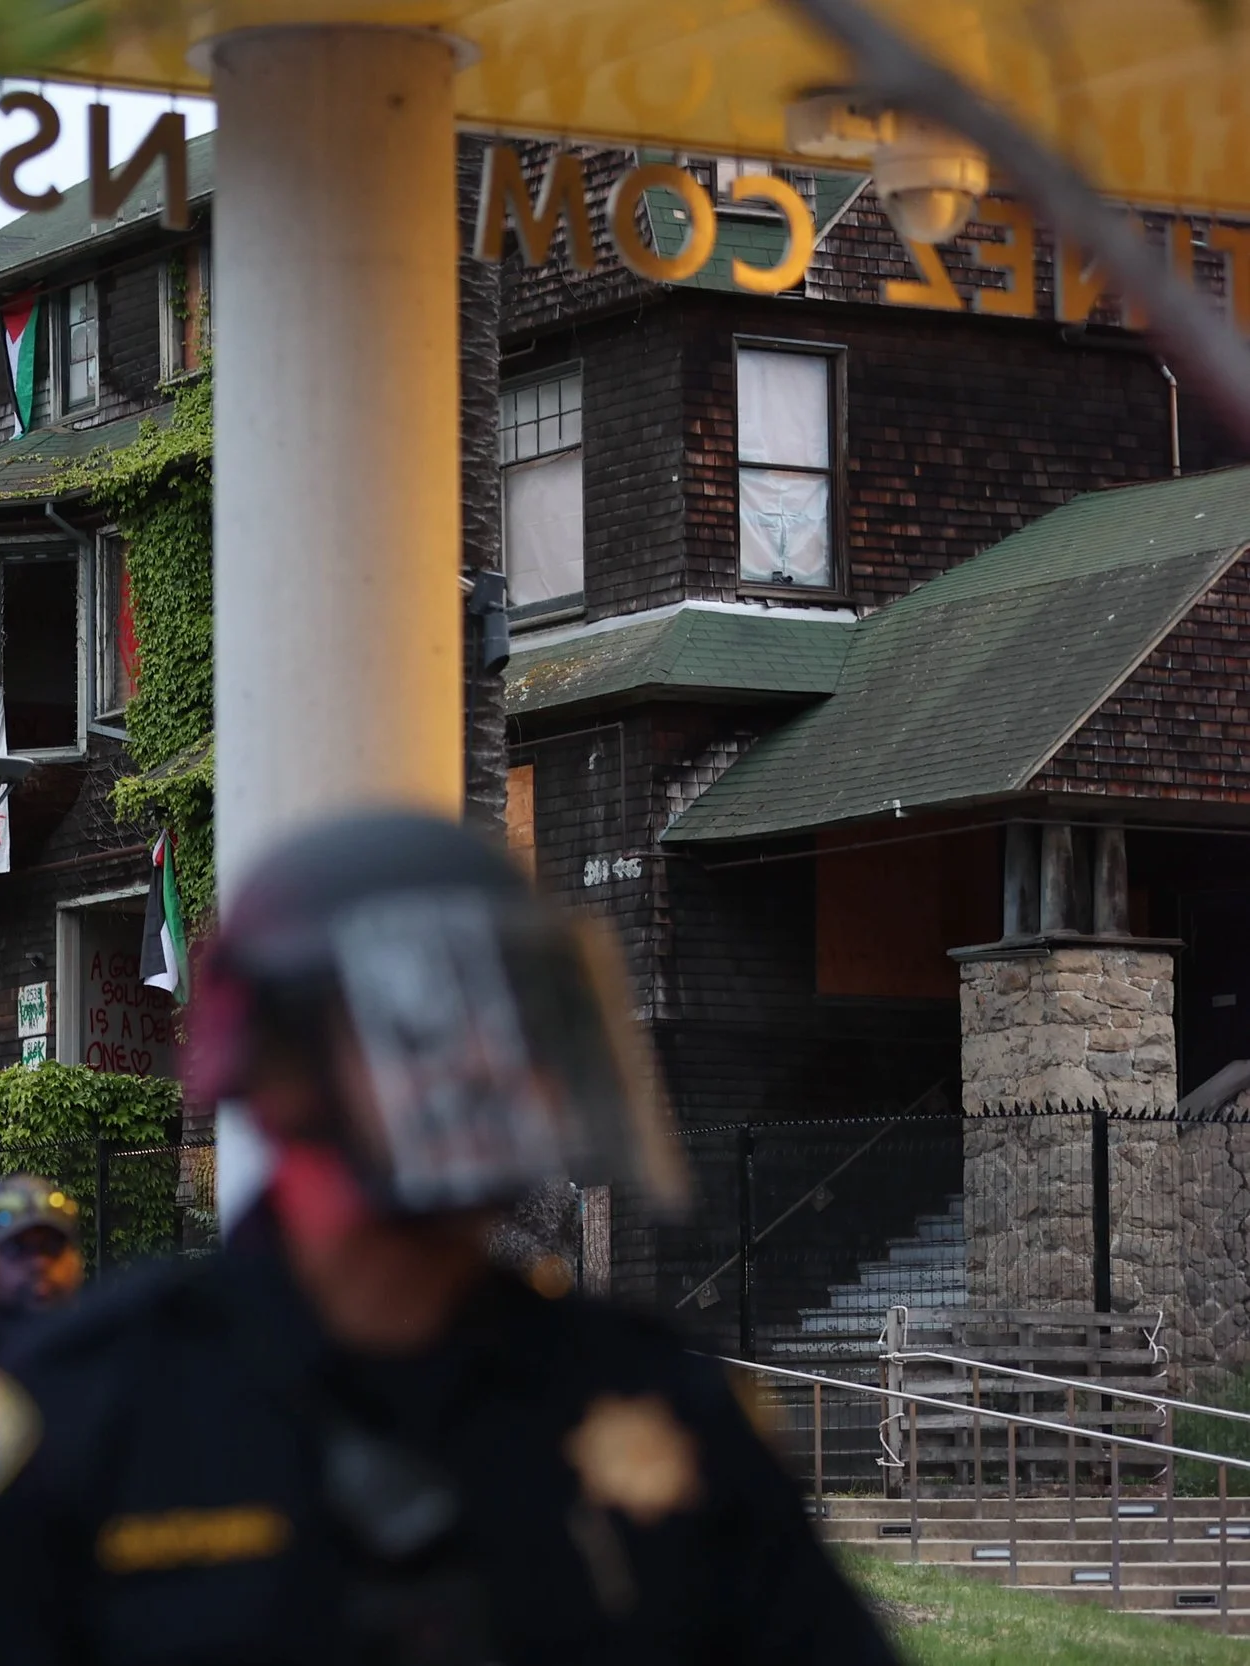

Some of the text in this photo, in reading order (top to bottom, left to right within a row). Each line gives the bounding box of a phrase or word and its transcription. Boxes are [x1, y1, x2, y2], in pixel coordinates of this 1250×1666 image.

[91, 951, 103, 981] A
[89, 1008, 109, 1037] IS
[121, 1012, 133, 1039] A
[86, 1041, 130, 1072] ONE
